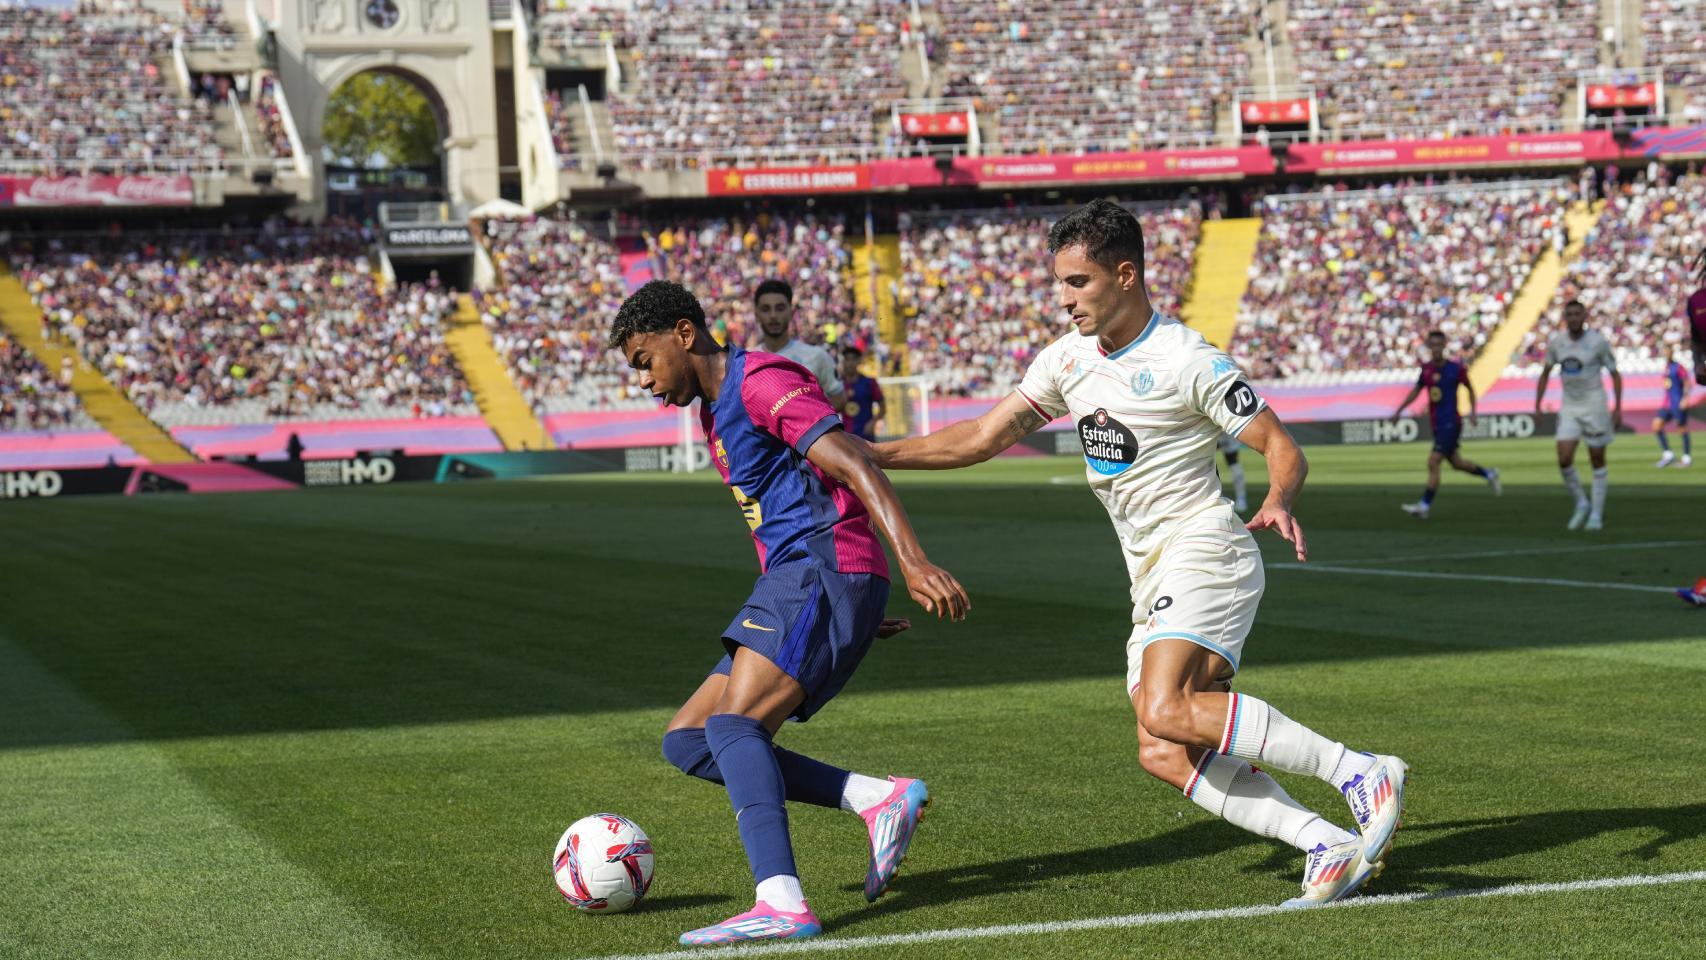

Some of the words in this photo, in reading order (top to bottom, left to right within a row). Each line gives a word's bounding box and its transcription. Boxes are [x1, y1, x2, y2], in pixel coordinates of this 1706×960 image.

[743, 173, 810, 190] ESTRELLA
[811, 171, 857, 187] DAMM
[389, 228, 470, 243] BARCELONA
[770, 388, 802, 416] AMBILIGHT
[1234, 386, 1253, 414] JD
[1082, 424, 1125, 445] Estrella
[1490, 414, 1535, 438] HMD
[1085, 440, 1123, 460] Galicia
[341, 458, 395, 485] HMD
[6, 470, 63, 498] HMD
